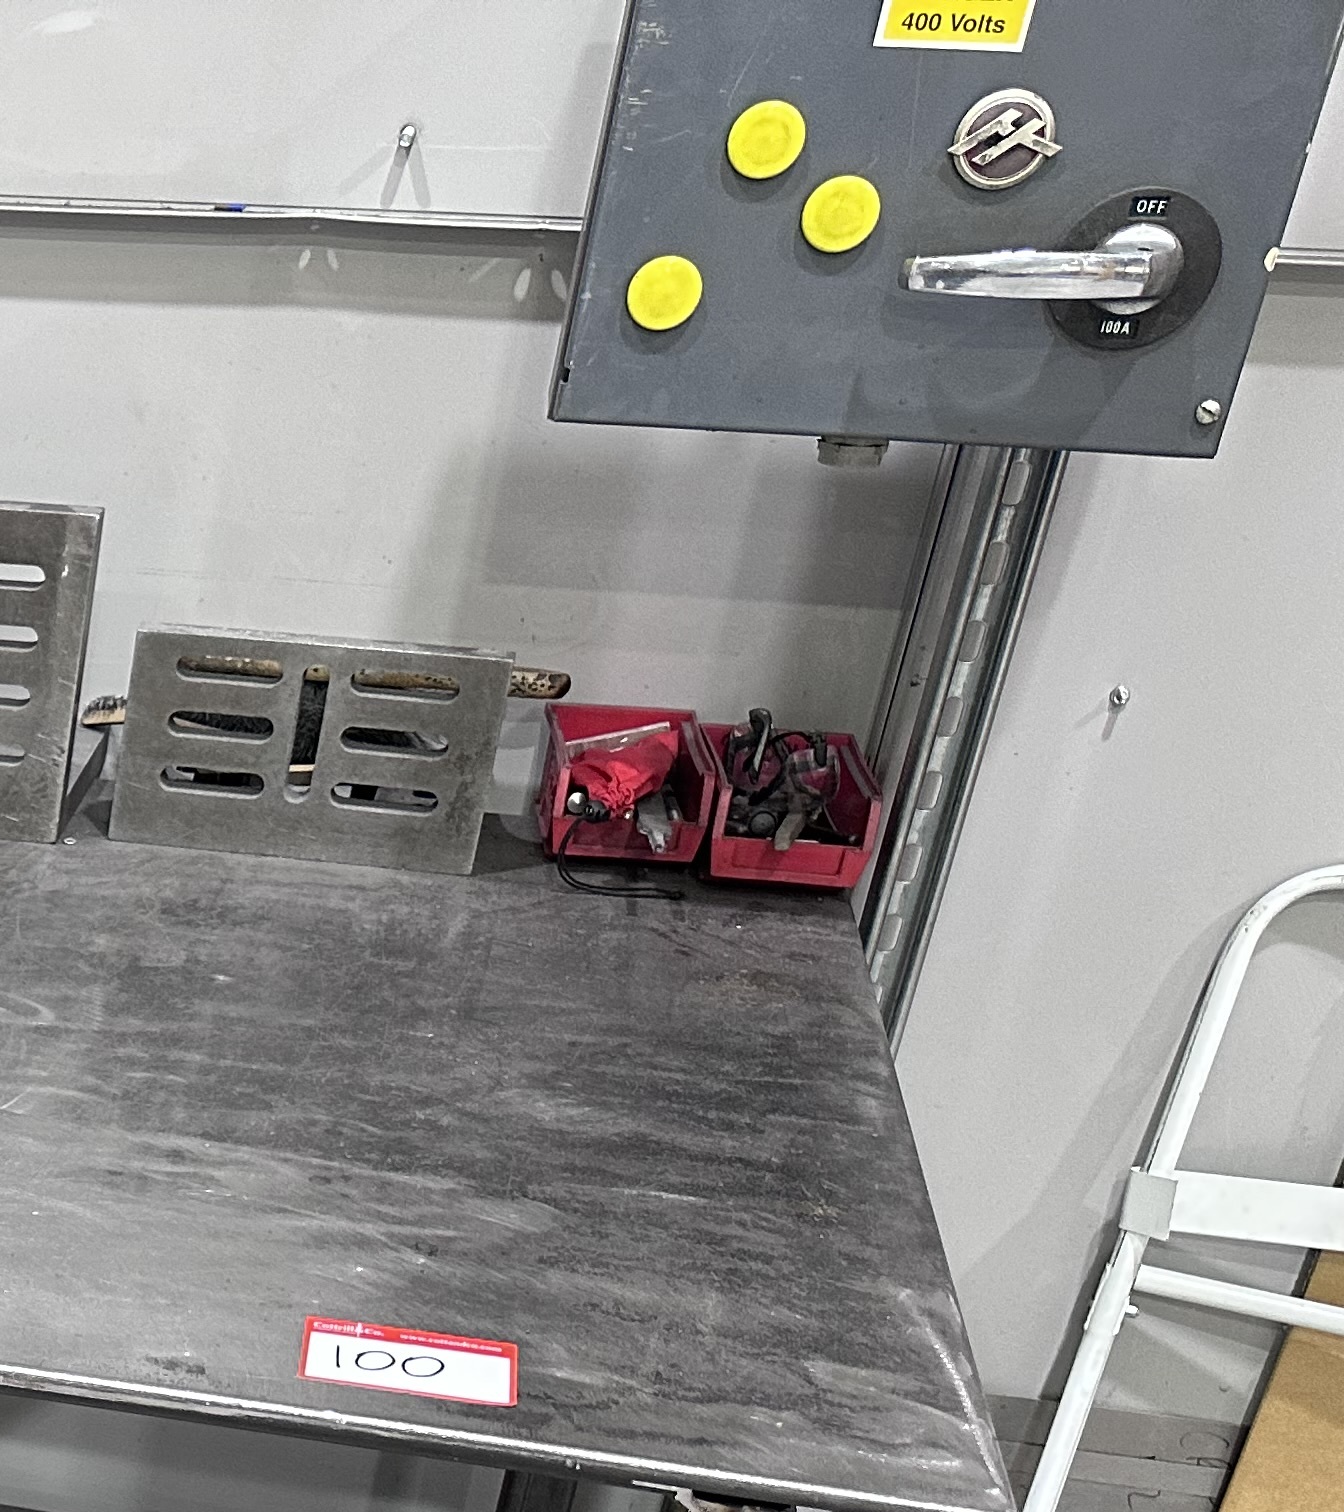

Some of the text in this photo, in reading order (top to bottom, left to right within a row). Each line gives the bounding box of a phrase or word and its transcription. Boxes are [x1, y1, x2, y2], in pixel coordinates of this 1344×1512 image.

[901, 12, 1006, 33] 400 Volts
[1136, 200, 1168, 214] OFF
[1100, 320, 1130, 335] 100A
[335, 1344, 445, 1377] 100
